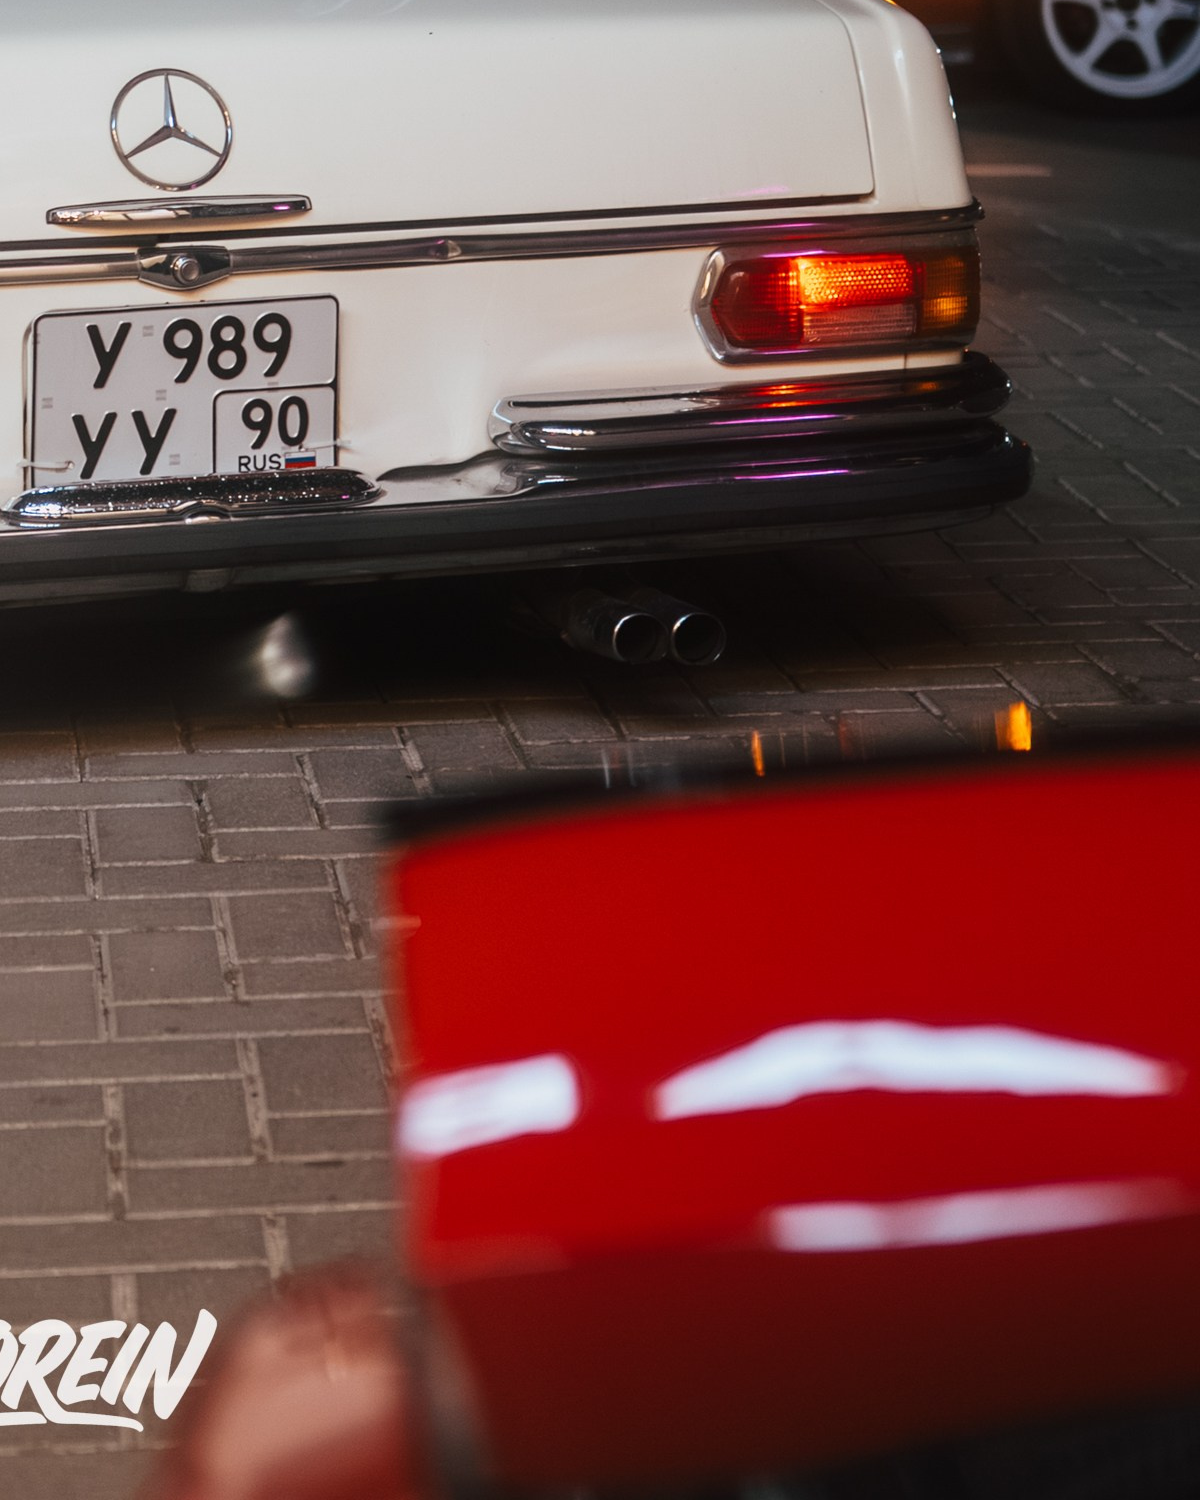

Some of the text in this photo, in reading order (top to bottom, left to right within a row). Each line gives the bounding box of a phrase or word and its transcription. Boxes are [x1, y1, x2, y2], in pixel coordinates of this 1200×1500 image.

[163, 312, 292, 384] 989
[241, 395, 309, 450] 90
[238, 453, 282, 473] RUS
